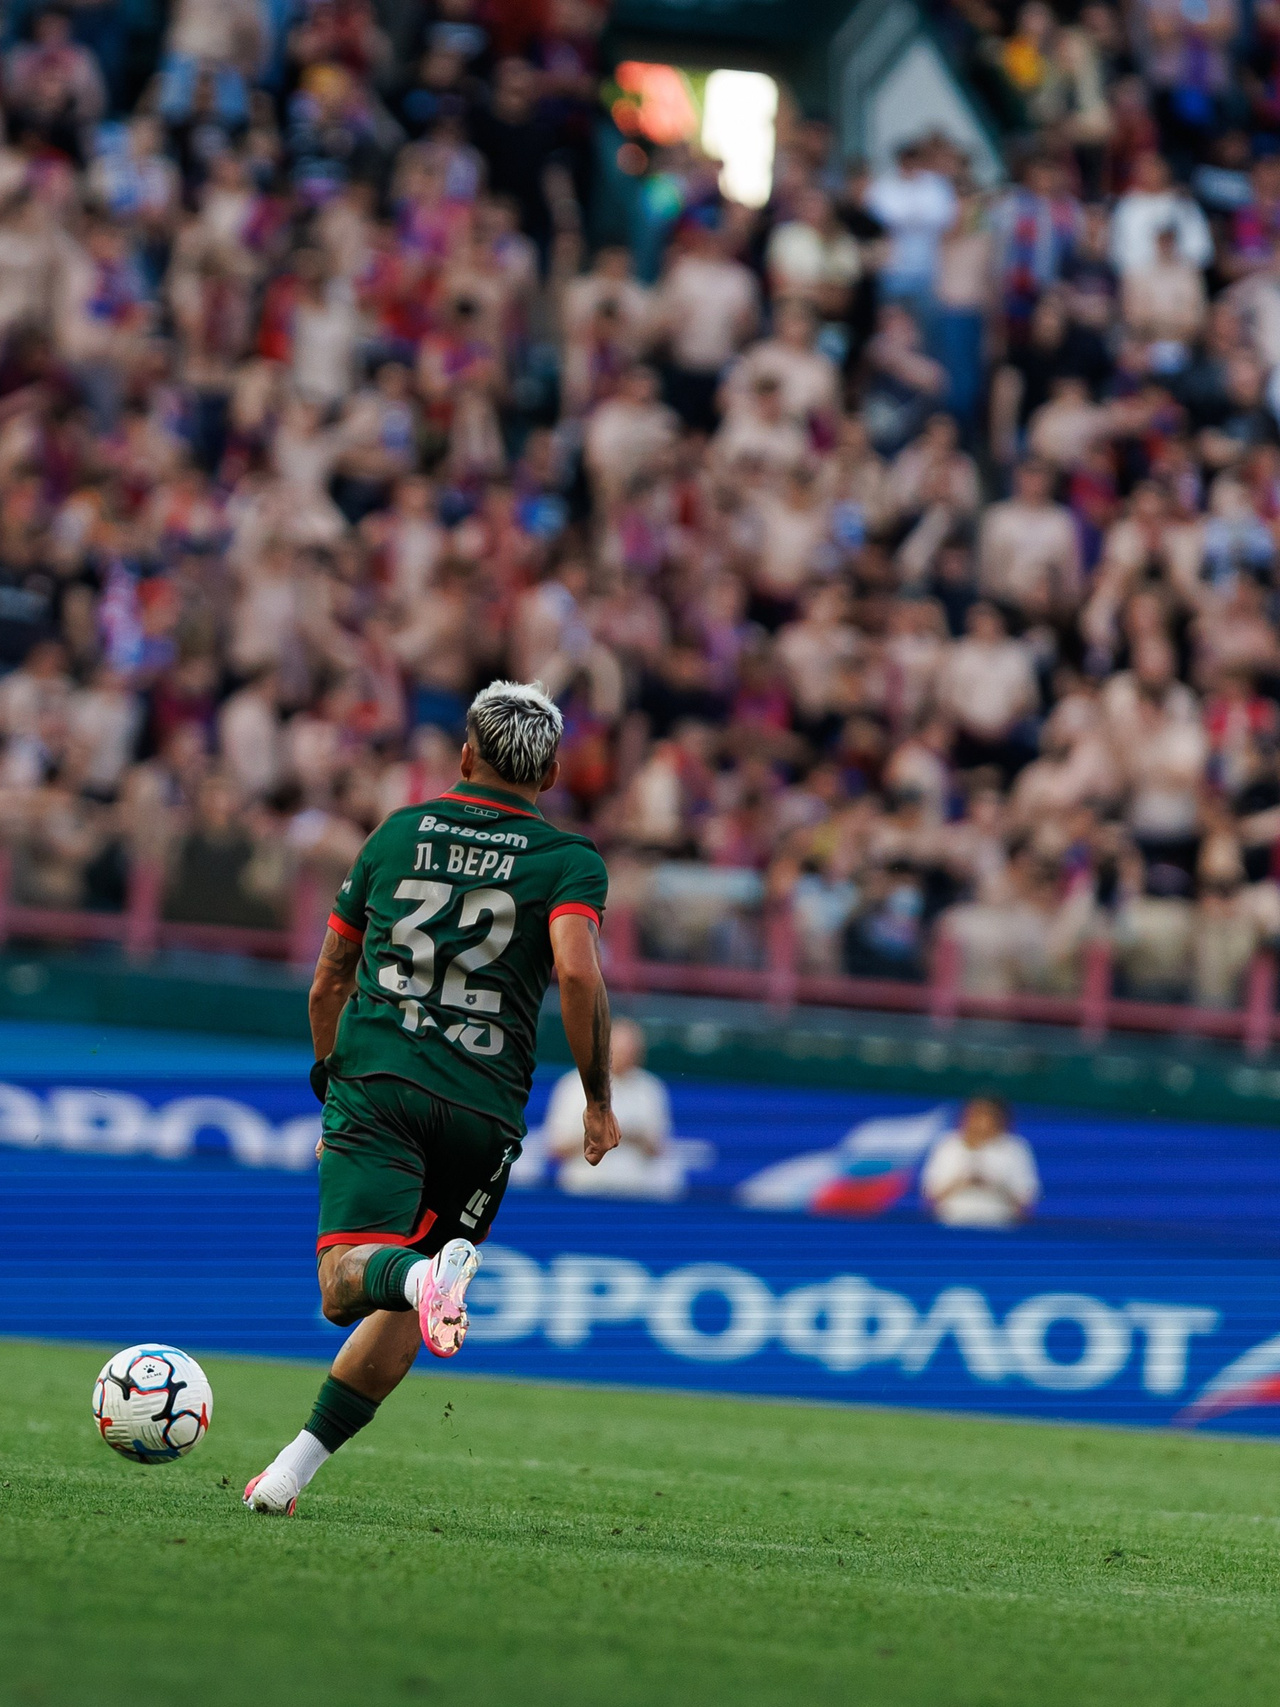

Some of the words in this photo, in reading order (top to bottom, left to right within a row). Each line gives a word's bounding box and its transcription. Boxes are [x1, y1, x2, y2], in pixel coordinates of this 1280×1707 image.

[413, 842, 440, 871] Л.
[446, 844, 516, 880] ВЕРА
[418, 815, 529, 849] BetBoom
[378, 879, 517, 1014] 32
[468, 1242, 1220, 1396] ЭРОФЛОТ
